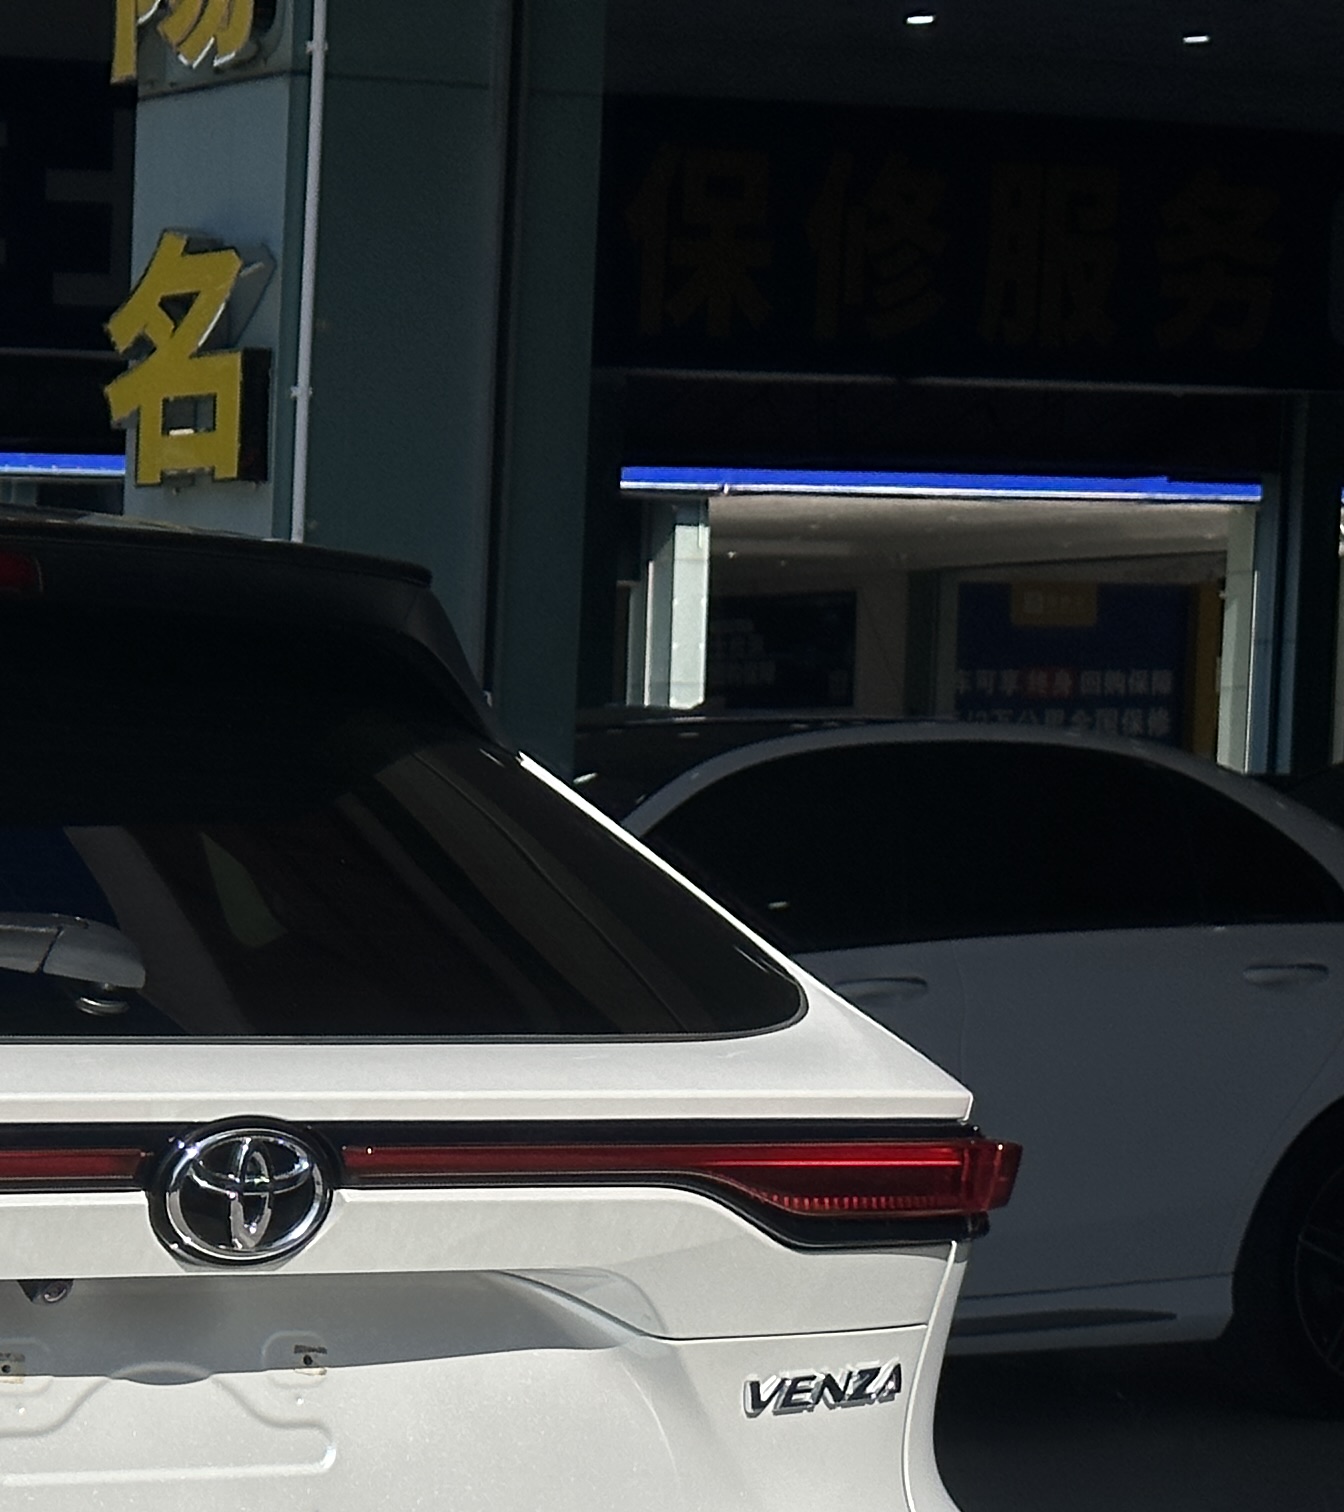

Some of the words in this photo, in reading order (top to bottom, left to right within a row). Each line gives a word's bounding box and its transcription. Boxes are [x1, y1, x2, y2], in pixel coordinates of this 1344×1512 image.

[623, 139, 1284, 352] 保修服务
[743, 1361, 902, 1418] VENZA
